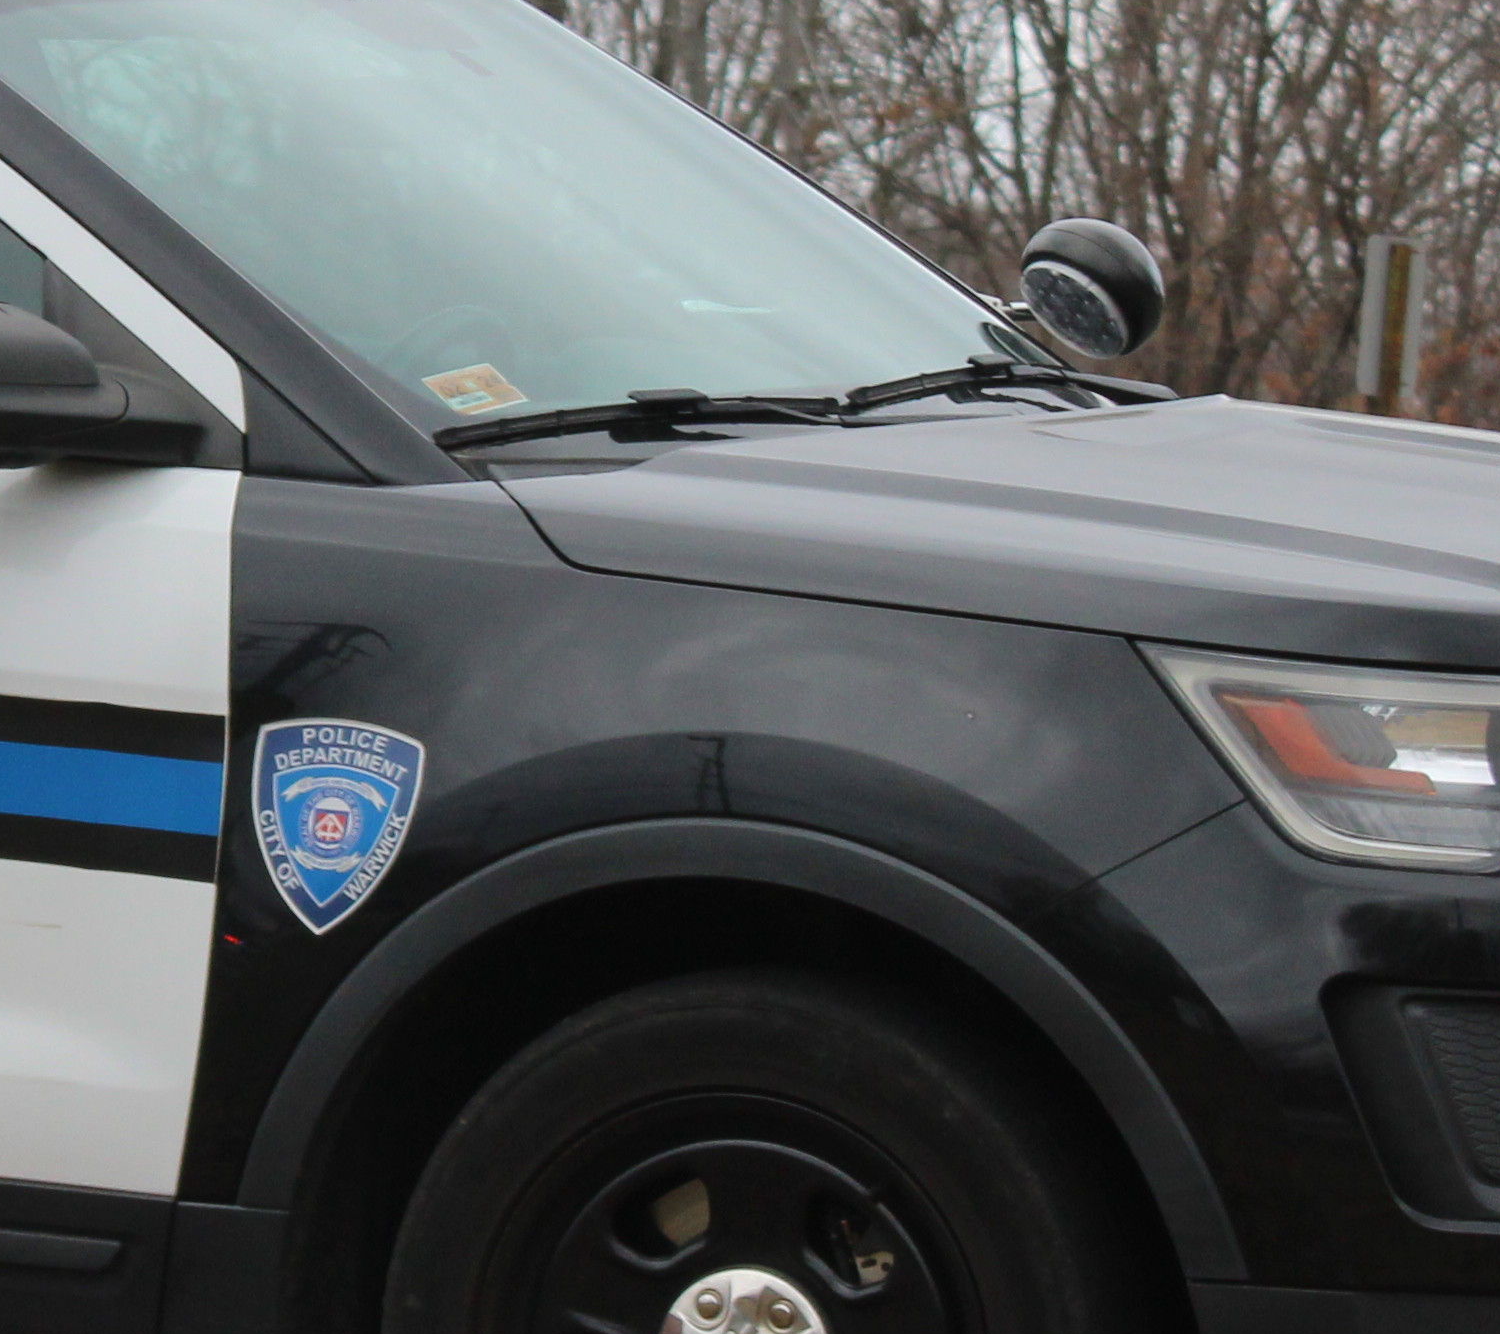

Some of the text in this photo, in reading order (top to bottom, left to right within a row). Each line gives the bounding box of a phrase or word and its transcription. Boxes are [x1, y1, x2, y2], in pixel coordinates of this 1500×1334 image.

[273, 746, 409, 782] DEPARTMENT
[302, 726, 389, 755] POLICE
[259, 809, 301, 891] CITY OF
[343, 812, 408, 901] WARWICK
